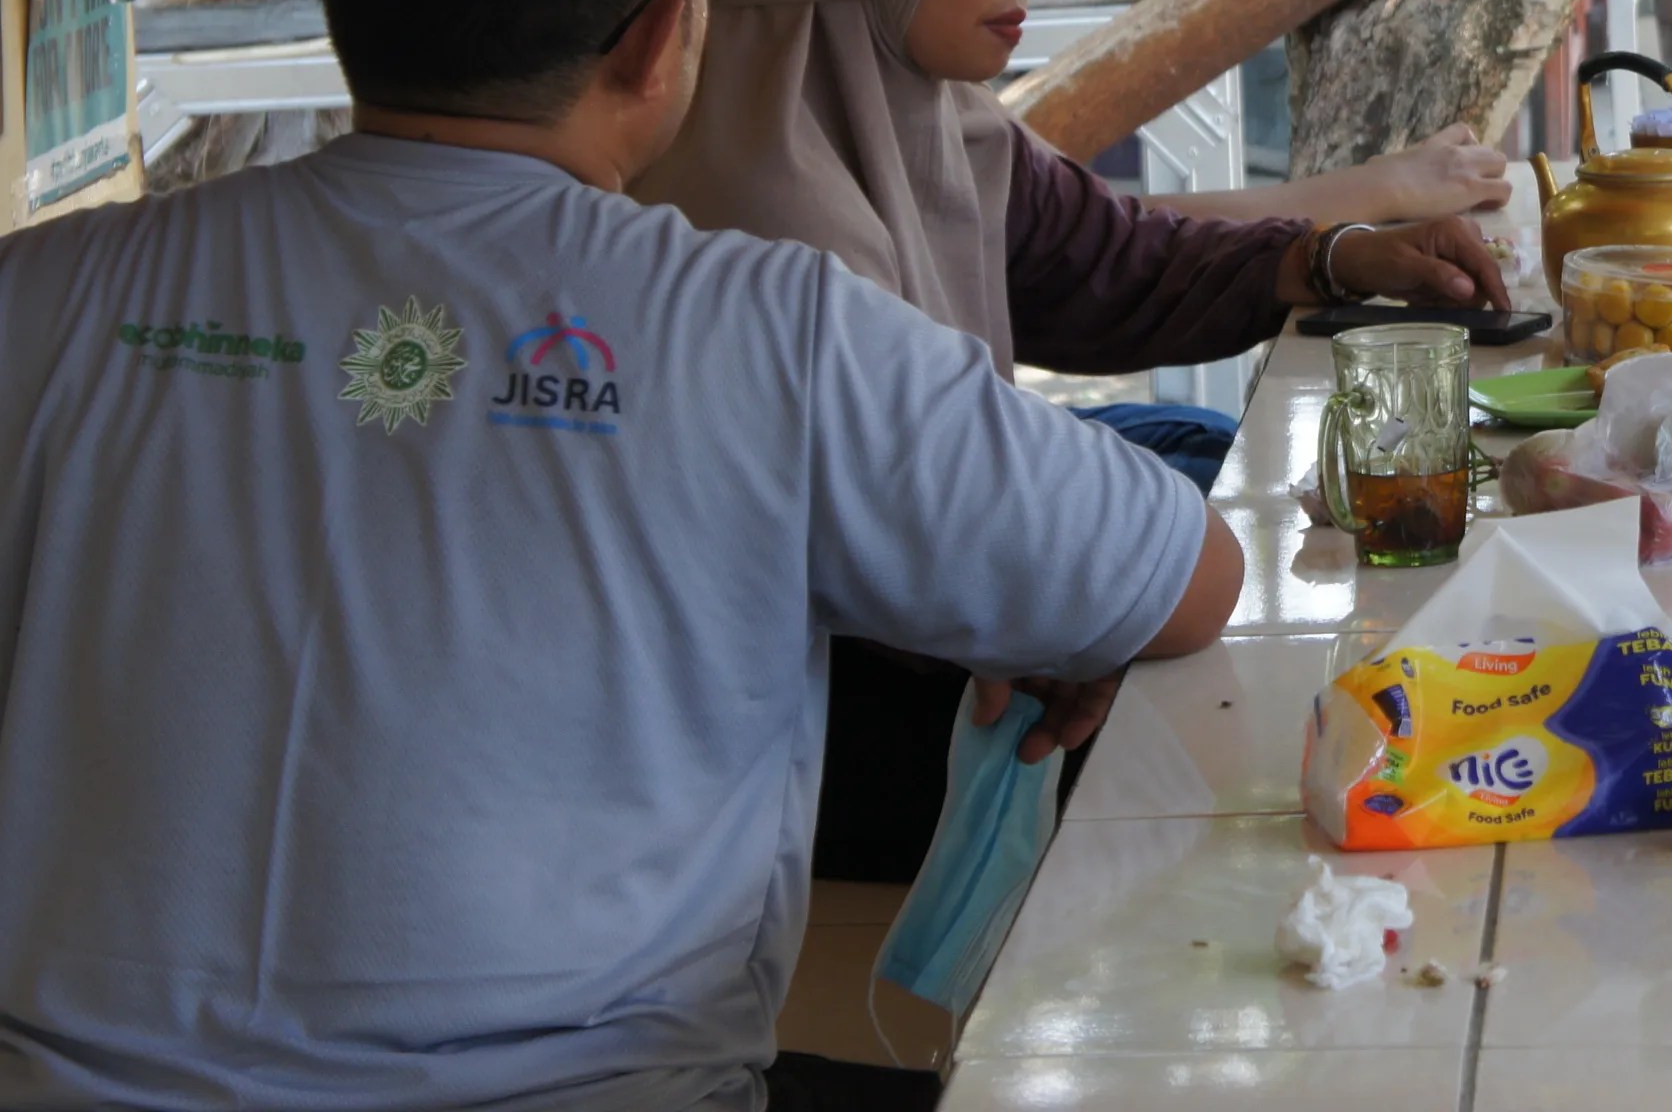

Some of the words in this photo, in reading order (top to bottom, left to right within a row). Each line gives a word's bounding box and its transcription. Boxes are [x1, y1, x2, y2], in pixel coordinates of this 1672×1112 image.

[491, 372, 621, 414] JISRA
[1474, 658, 1518, 673] Living
[1452, 698, 1502, 716] Food
[1508, 683, 1552, 707] Safe
[1468, 811, 1502, 825] Food
[1505, 807, 1536, 823] Safe
